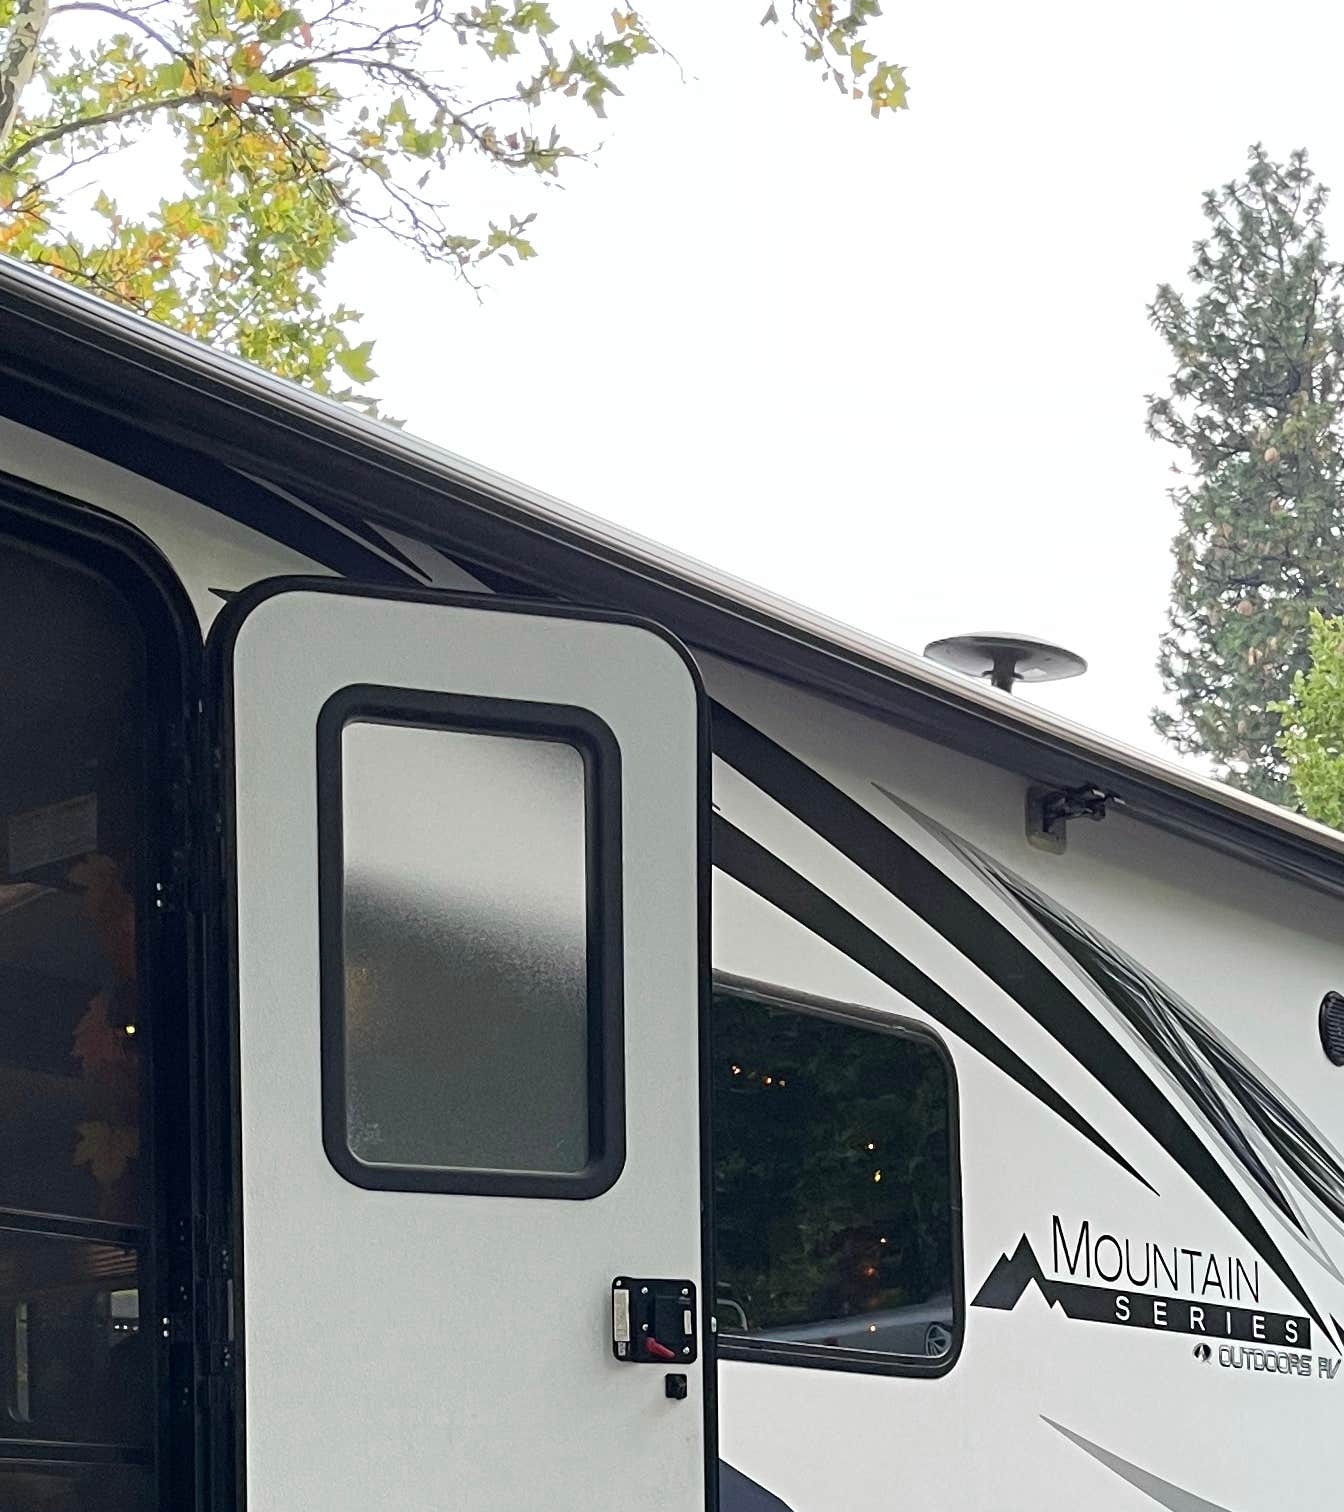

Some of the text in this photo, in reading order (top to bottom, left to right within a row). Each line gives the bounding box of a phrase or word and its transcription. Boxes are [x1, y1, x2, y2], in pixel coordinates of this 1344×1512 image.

[1052, 1214, 1259, 1303] MOUNTAIN
[1115, 1295, 1299, 1344] SERIES
[1218, 1344, 1342, 1380] OUTDOORS RV
